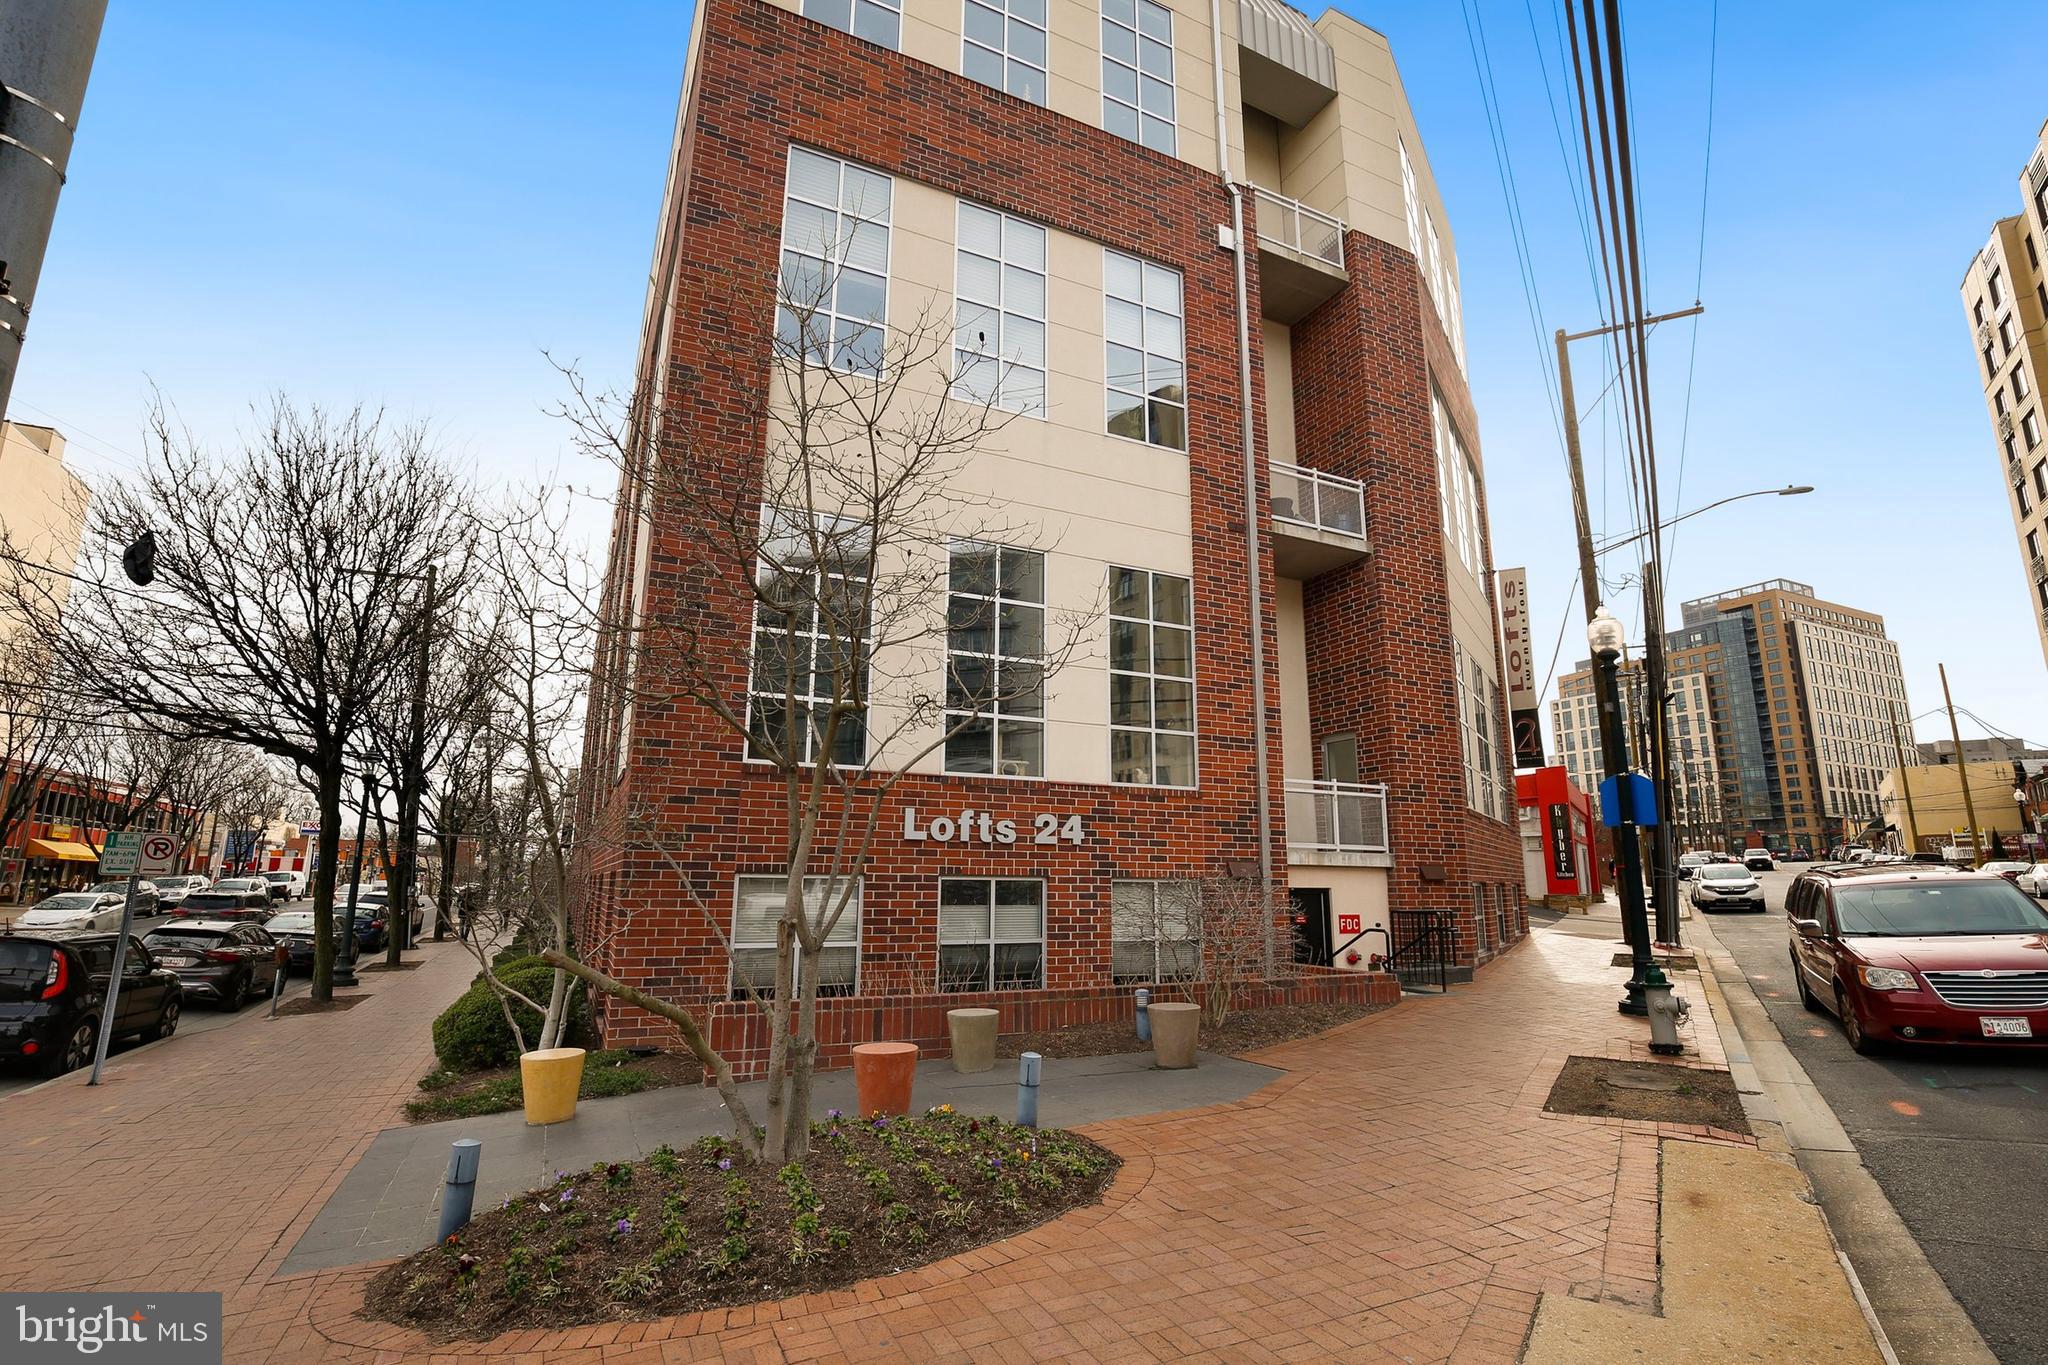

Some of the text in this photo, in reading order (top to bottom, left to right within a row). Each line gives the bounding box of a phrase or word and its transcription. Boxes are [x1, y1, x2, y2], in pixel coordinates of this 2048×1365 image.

[1516, 717, 1540, 756] 24
[904, 807, 1085, 846] Lofts 24
[1340, 918, 1360, 930] FDC
